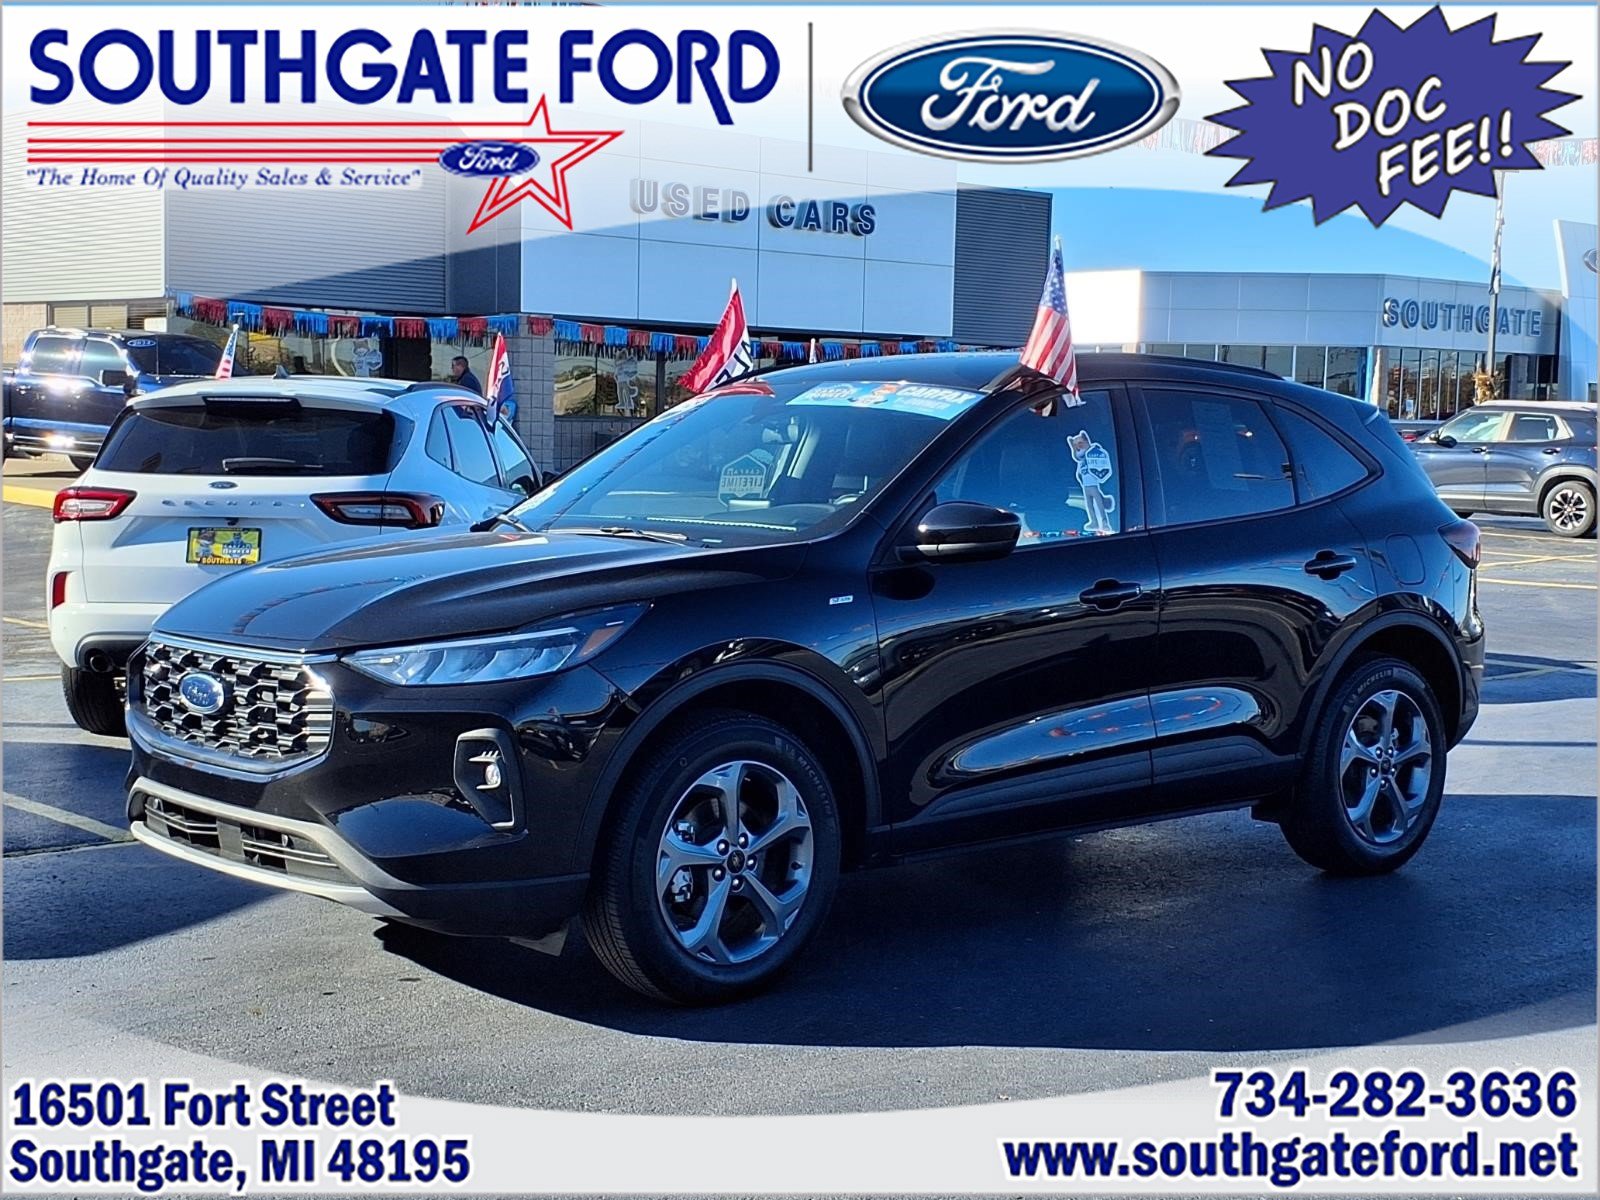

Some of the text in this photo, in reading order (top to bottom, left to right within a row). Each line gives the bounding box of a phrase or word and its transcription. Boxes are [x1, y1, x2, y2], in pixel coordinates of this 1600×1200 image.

[630, 178, 876, 236] USED CARS
[1383, 297, 1541, 337] SOUTHGATE
[1357, 669, 1393, 695] MICHELIN
